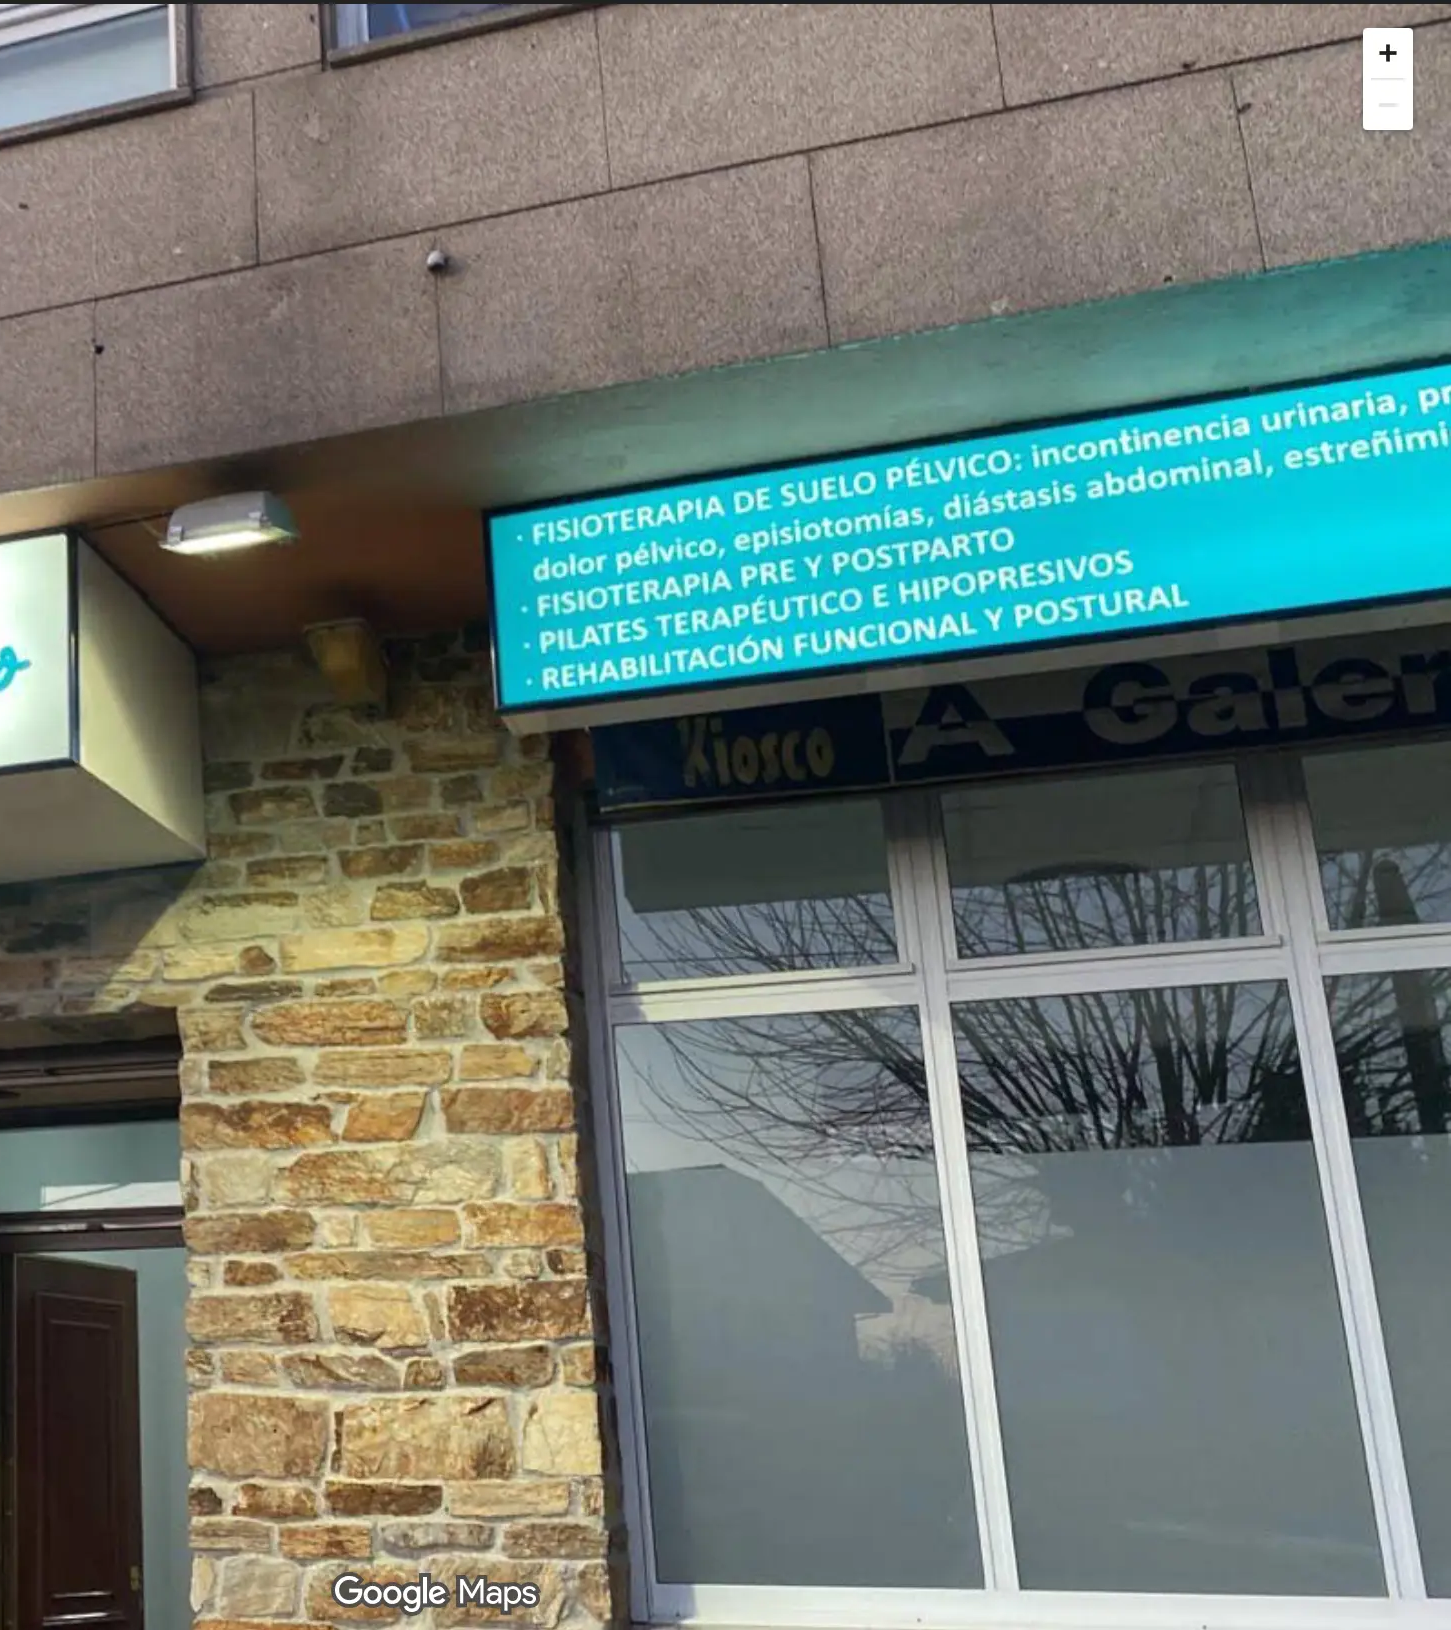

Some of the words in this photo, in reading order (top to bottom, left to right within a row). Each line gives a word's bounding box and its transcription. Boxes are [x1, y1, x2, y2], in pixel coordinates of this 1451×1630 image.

[532, 494, 725, 546] FISIOTERAPIA
[733, 486, 772, 515] DE
[779, 470, 878, 508] SUELO
[885, 448, 1022, 491] PÉLVICO:
[1030, 412, 1251, 469] incontinencia
[1260, 390, 1407, 433] urinaria,
[533, 551, 607, 582] dolor
[615, 537, 726, 575] pélvico,
[733, 500, 935, 555] episiotomías,
[943, 478, 1077, 521] diástasis
[1086, 447, 1274, 499] abdominal,
[1283, 420, 1450, 470] estreñimi
[537, 569, 732, 618] FISIOTERAPIA
[740, 558, 795, 589] PRE
[803, 554, 822, 579] Y
[832, 526, 1015, 574] POSTPARTO
[539, 616, 648, 654] PILATES
[656, 586, 863, 638] TERAPÉUTICO
[872, 583, 890, 609] E
[899, 549, 1134, 606] HIPOPRESIVOS
[542, 636, 785, 691] REHABILITACIÓN
[793, 611, 978, 658] FUNCIONAL
[983, 606, 1004, 632] Y
[1014, 584, 1190, 628] POSTURAL
[677, 713, 835, 788] Kiosco
[895, 682, 1015, 767] A
